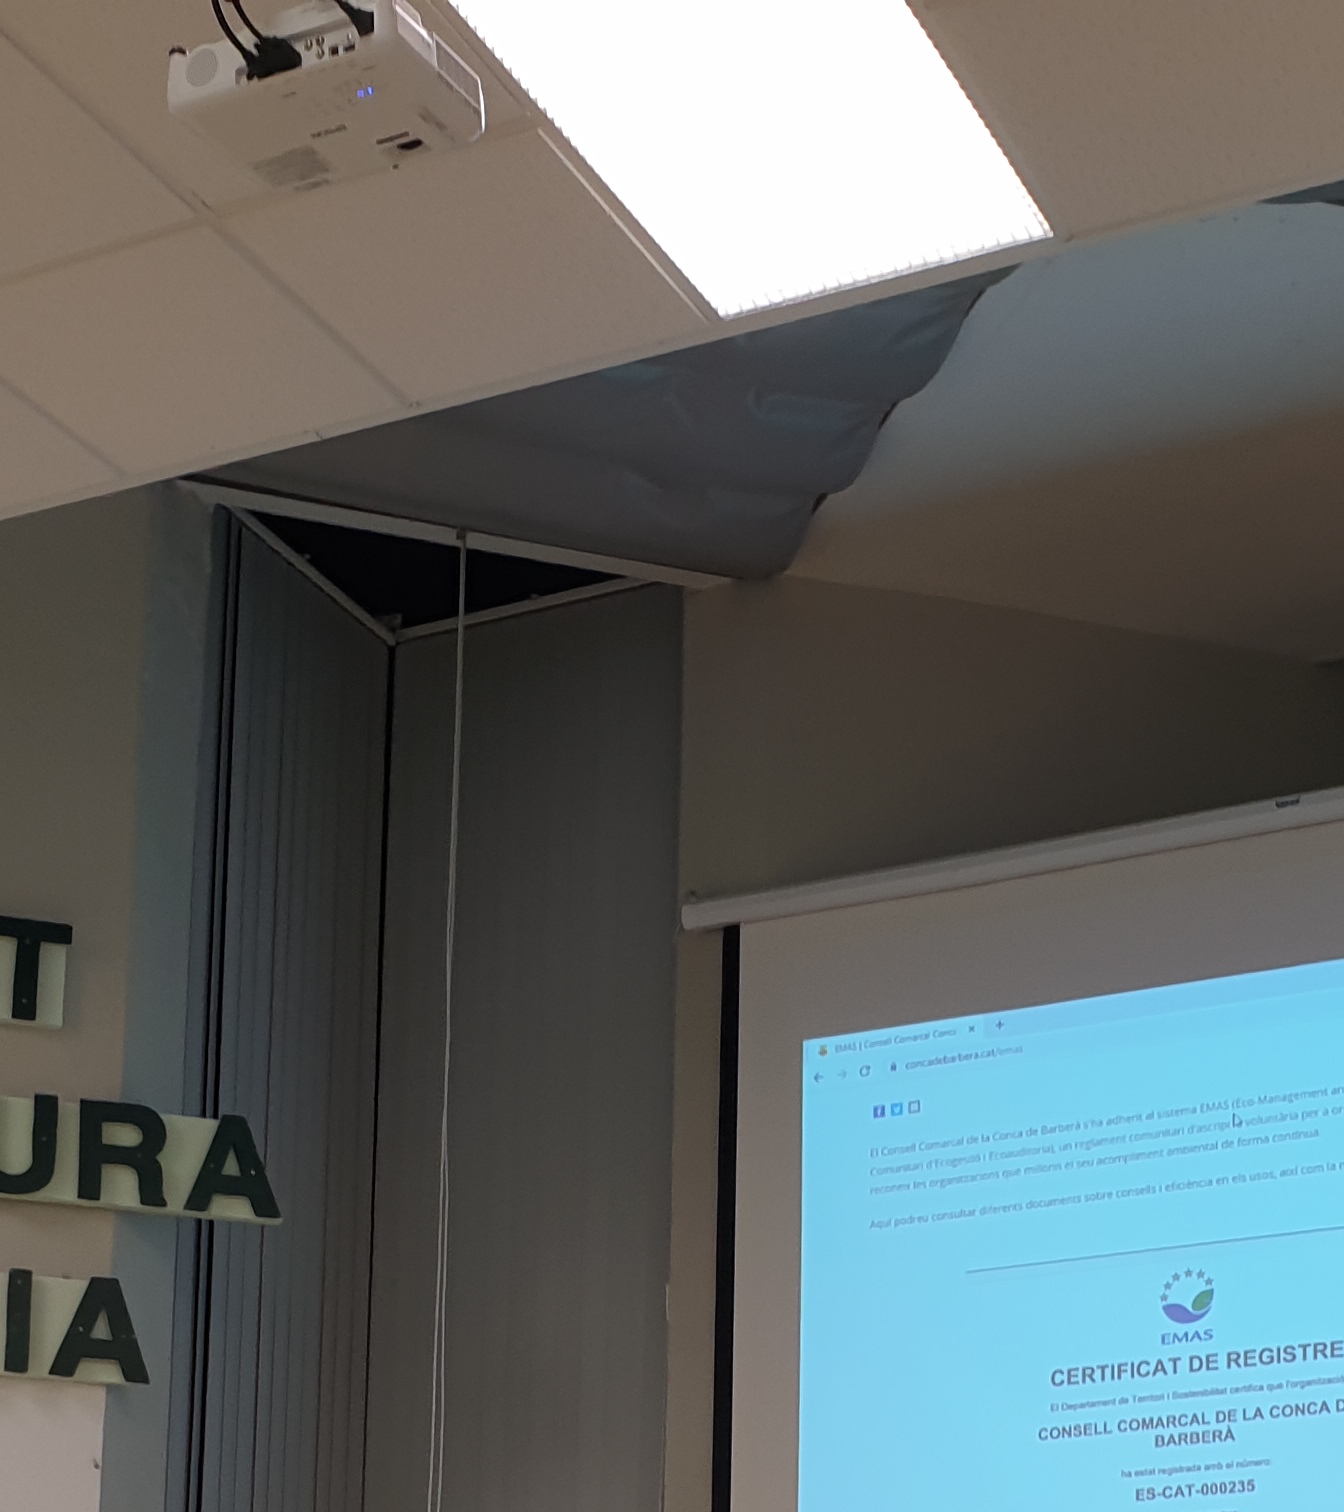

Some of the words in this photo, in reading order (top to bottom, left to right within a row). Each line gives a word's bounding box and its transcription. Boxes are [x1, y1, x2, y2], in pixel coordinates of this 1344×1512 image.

[1160, 1327, 1213, 1346] EMAS
[1050, 1355, 1181, 1387] CERTIFICAT
[1188, 1352, 1219, 1373] DE
[1226, 1339, 1344, 1370] REGISTRE
[1038, 1419, 1113, 1441] CONSELL
[1117, 1410, 1210, 1433] COMARCAL
[1215, 1408, 1237, 1424] DE
[1242, 1405, 1264, 1421] LA
[1268, 1399, 1331, 1419] CONCA
[1154, 1424, 1235, 1448] BARBERÀ
[1135, 1477, 1255, 1502] ES-CAT-000235
